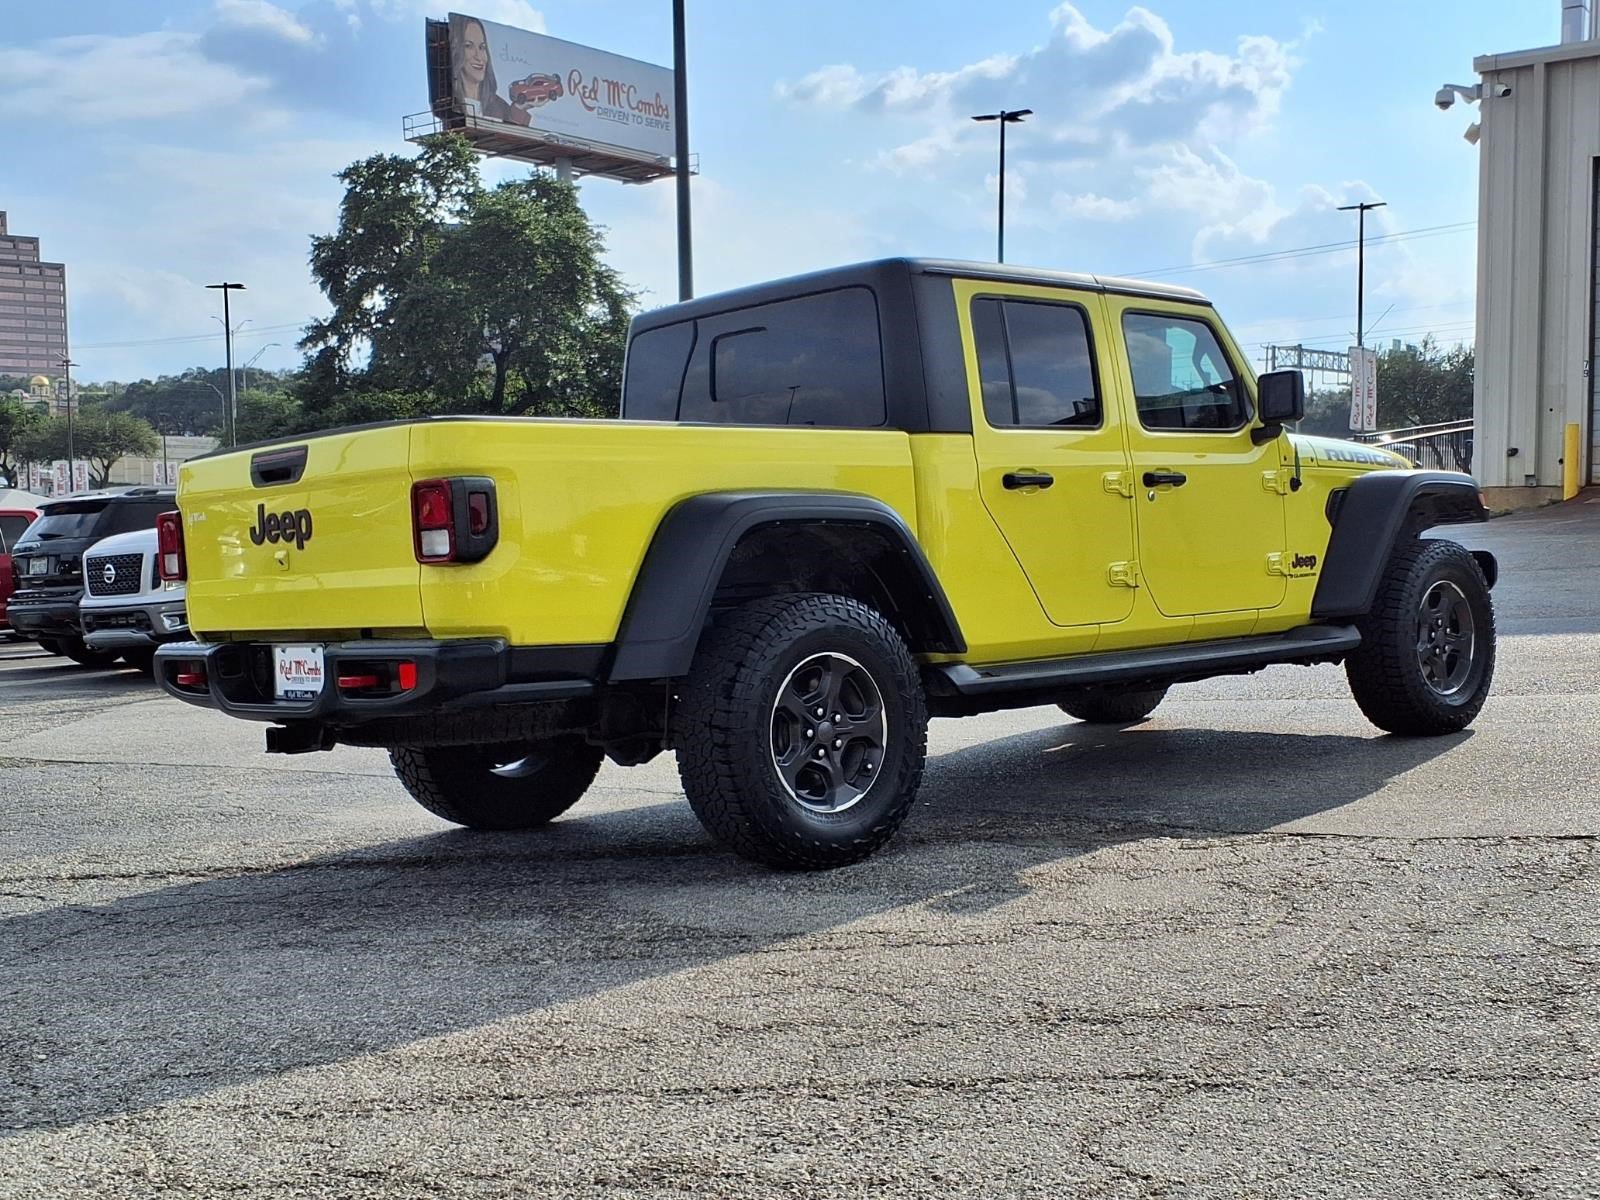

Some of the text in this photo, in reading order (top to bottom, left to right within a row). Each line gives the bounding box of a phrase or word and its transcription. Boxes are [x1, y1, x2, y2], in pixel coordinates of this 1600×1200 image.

[568, 69, 670, 119] Red McCombs
[596, 106, 629, 122] DRIVEN
[631, 114, 644, 126] TO
[645, 117, 671, 131] SERVE
[249, 503, 313, 551] Jeep
[1291, 552, 1317, 571] Jeep
[279, 659, 321, 681] Red McCombs
